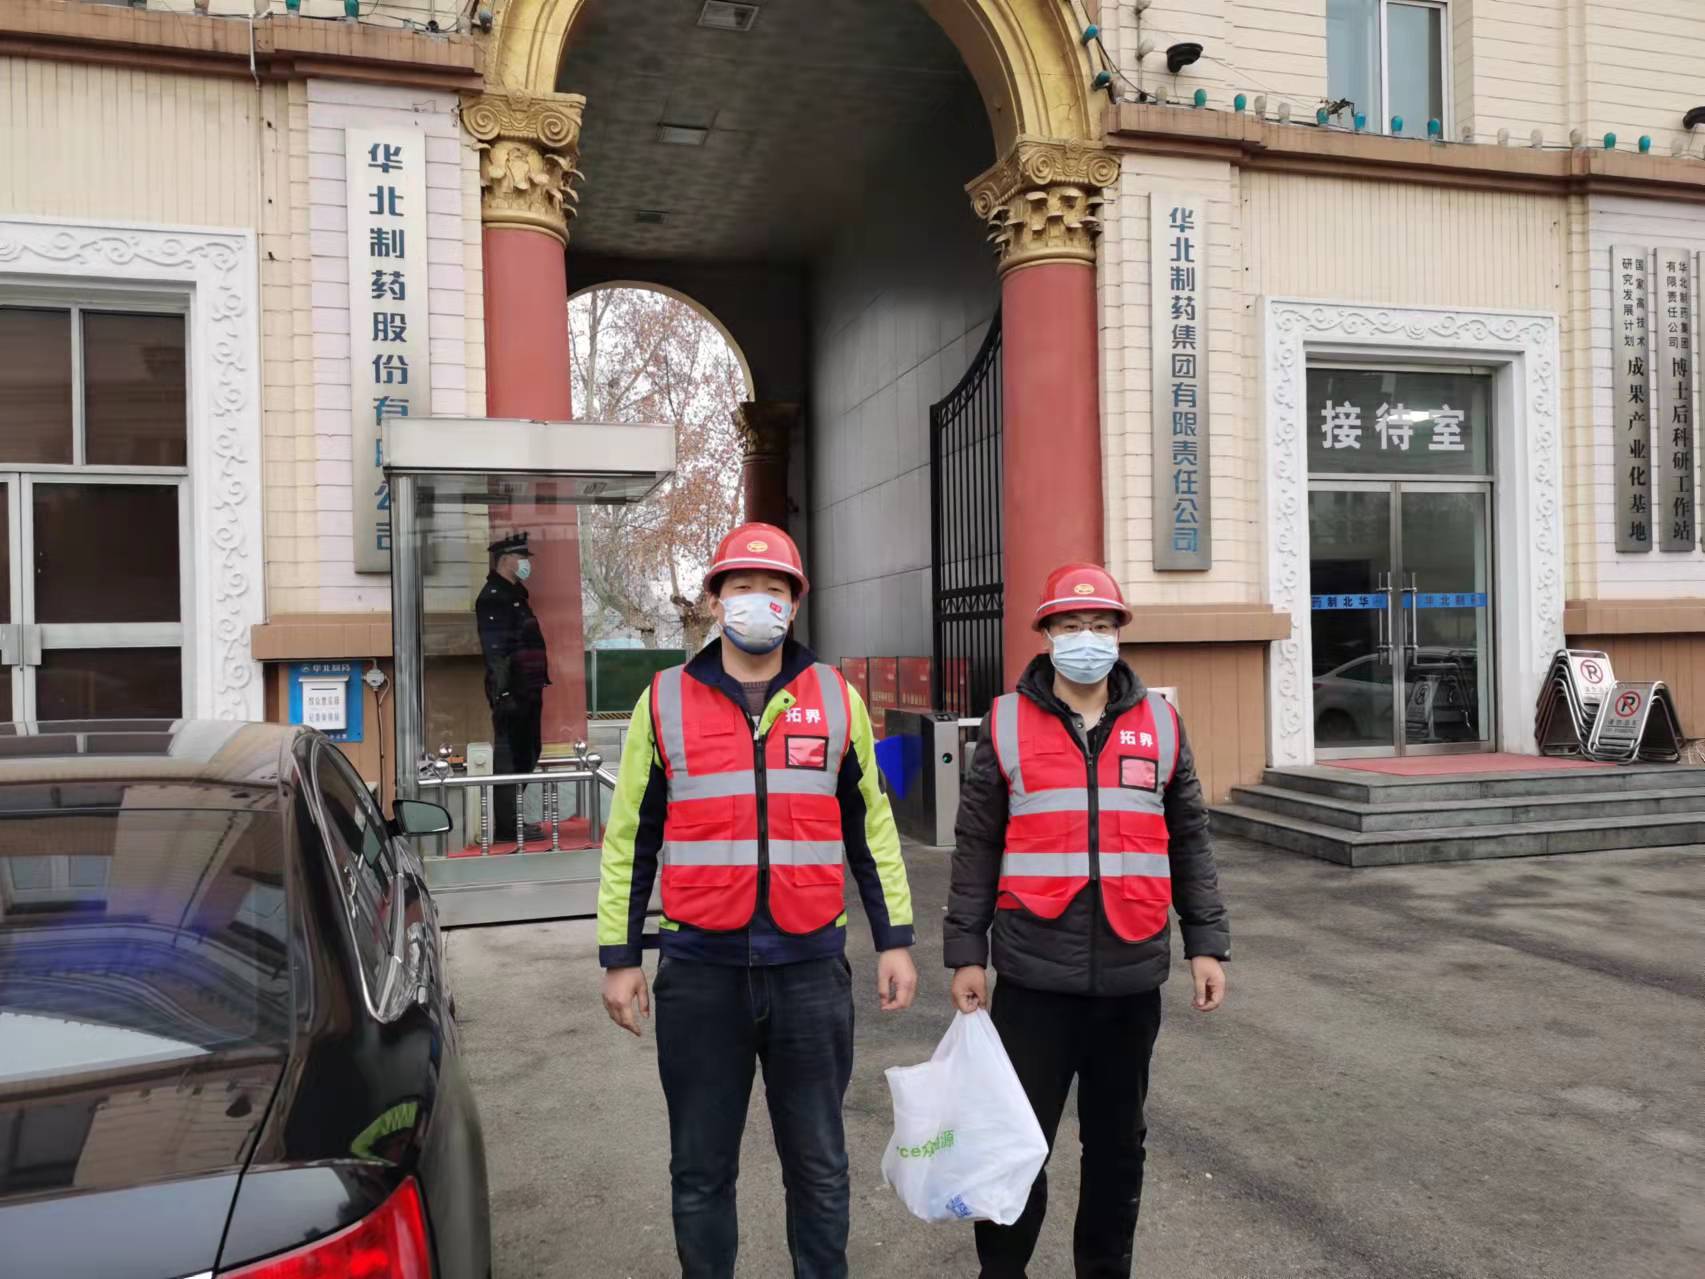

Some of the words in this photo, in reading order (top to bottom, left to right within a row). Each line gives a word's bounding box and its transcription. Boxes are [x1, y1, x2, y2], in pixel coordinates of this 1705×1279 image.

[368, 143, 409, 549] 华北制药股份有
[1622, 258, 1634, 347] 研究发展计划
[1635, 259, 1646, 347] 国家高技术
[1666, 261, 1679, 349] 有限责任公司
[1679, 261, 1689, 349] 华北制药集团
[1169, 207, 1198, 552] 华北制药集团有限责任公司
[1321, 400, 1465, 450] 接待室
[1627, 357, 1647, 541] 成果产业化基地
[1672, 357, 1690, 541] 博士后科研工作站
[785, 707, 821, 724] 拓界
[1120, 729, 1153, 747] 拓界
